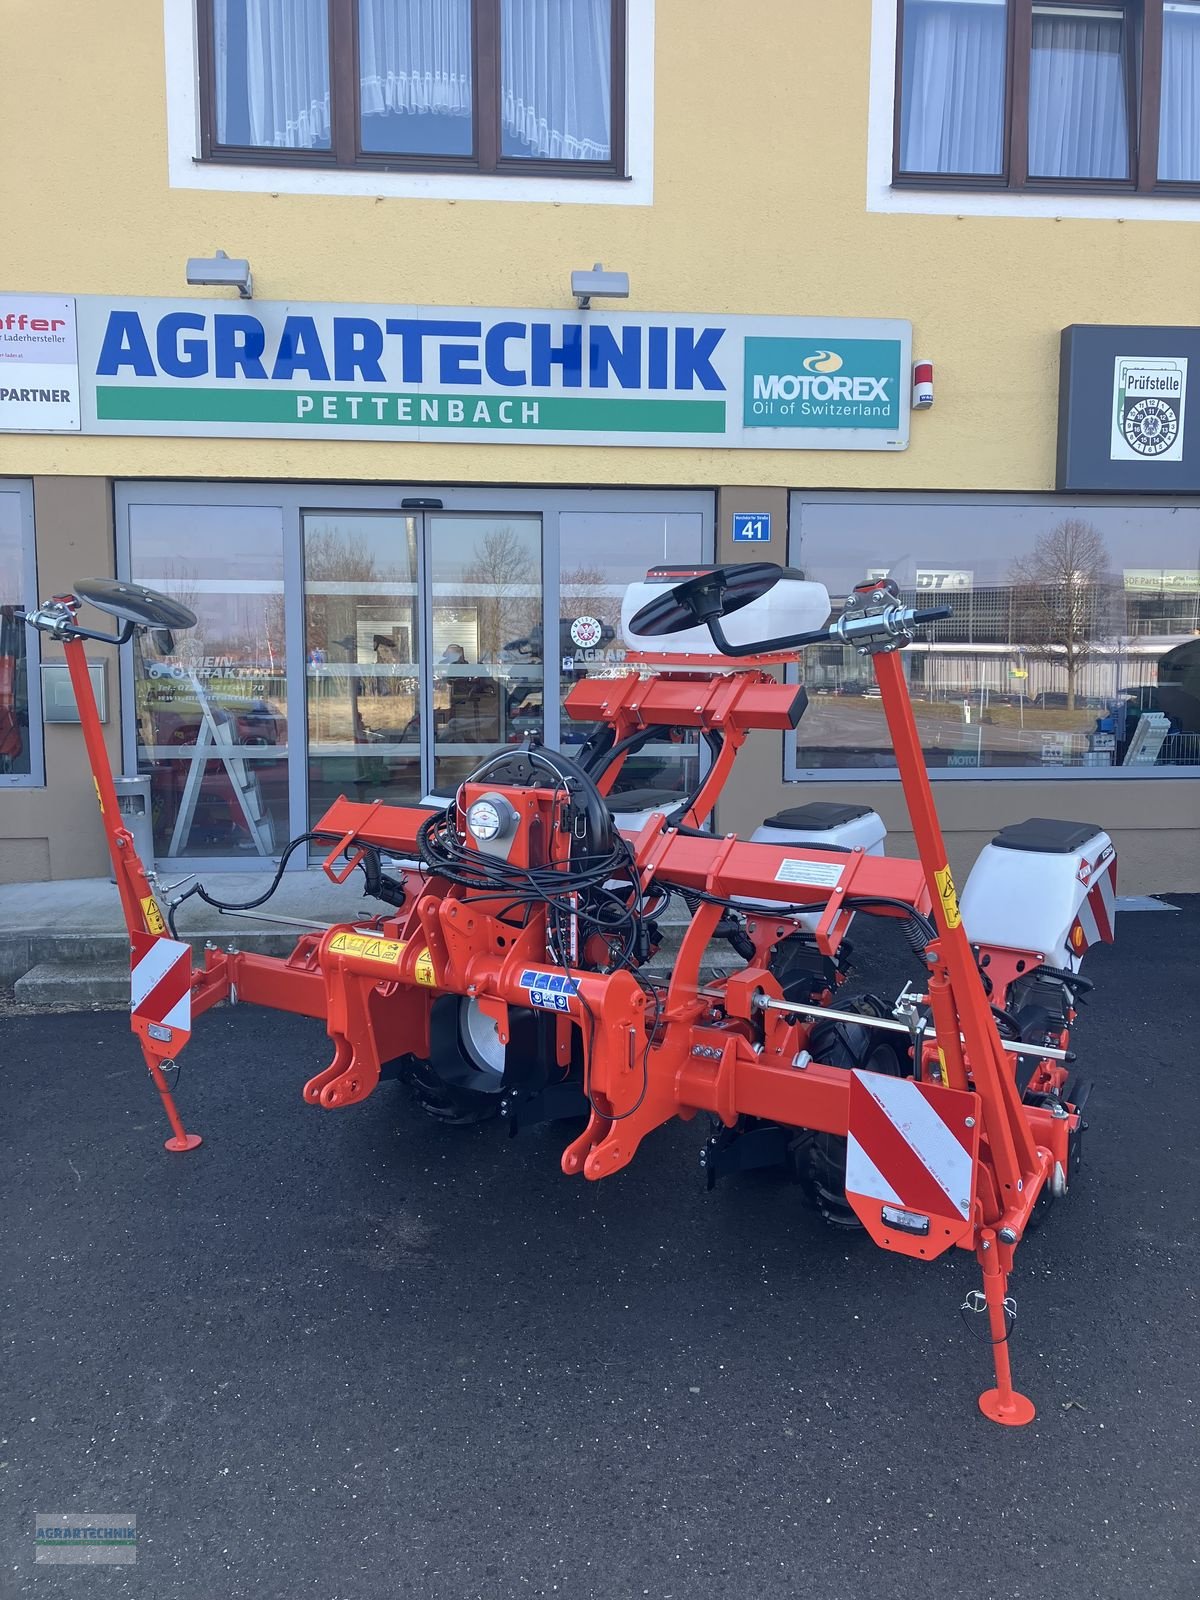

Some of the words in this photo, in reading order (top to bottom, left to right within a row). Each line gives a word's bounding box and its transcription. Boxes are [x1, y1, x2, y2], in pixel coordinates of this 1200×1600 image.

[0, 314, 66, 331] ffer
[4, 334, 66, 343] Laderhersteller
[96, 311, 726, 391] AGRARTECHNIK
[1128, 376, 1179, 390] Prüfstelle
[0, 388, 71, 403] PARTNER
[297, 395, 540, 425] PETTENBACH
[753, 401, 773, 416] Oil
[780, 401, 795, 416] of
[801, 401, 891, 417] Switzerland
[742, 521, 762, 539] 41
